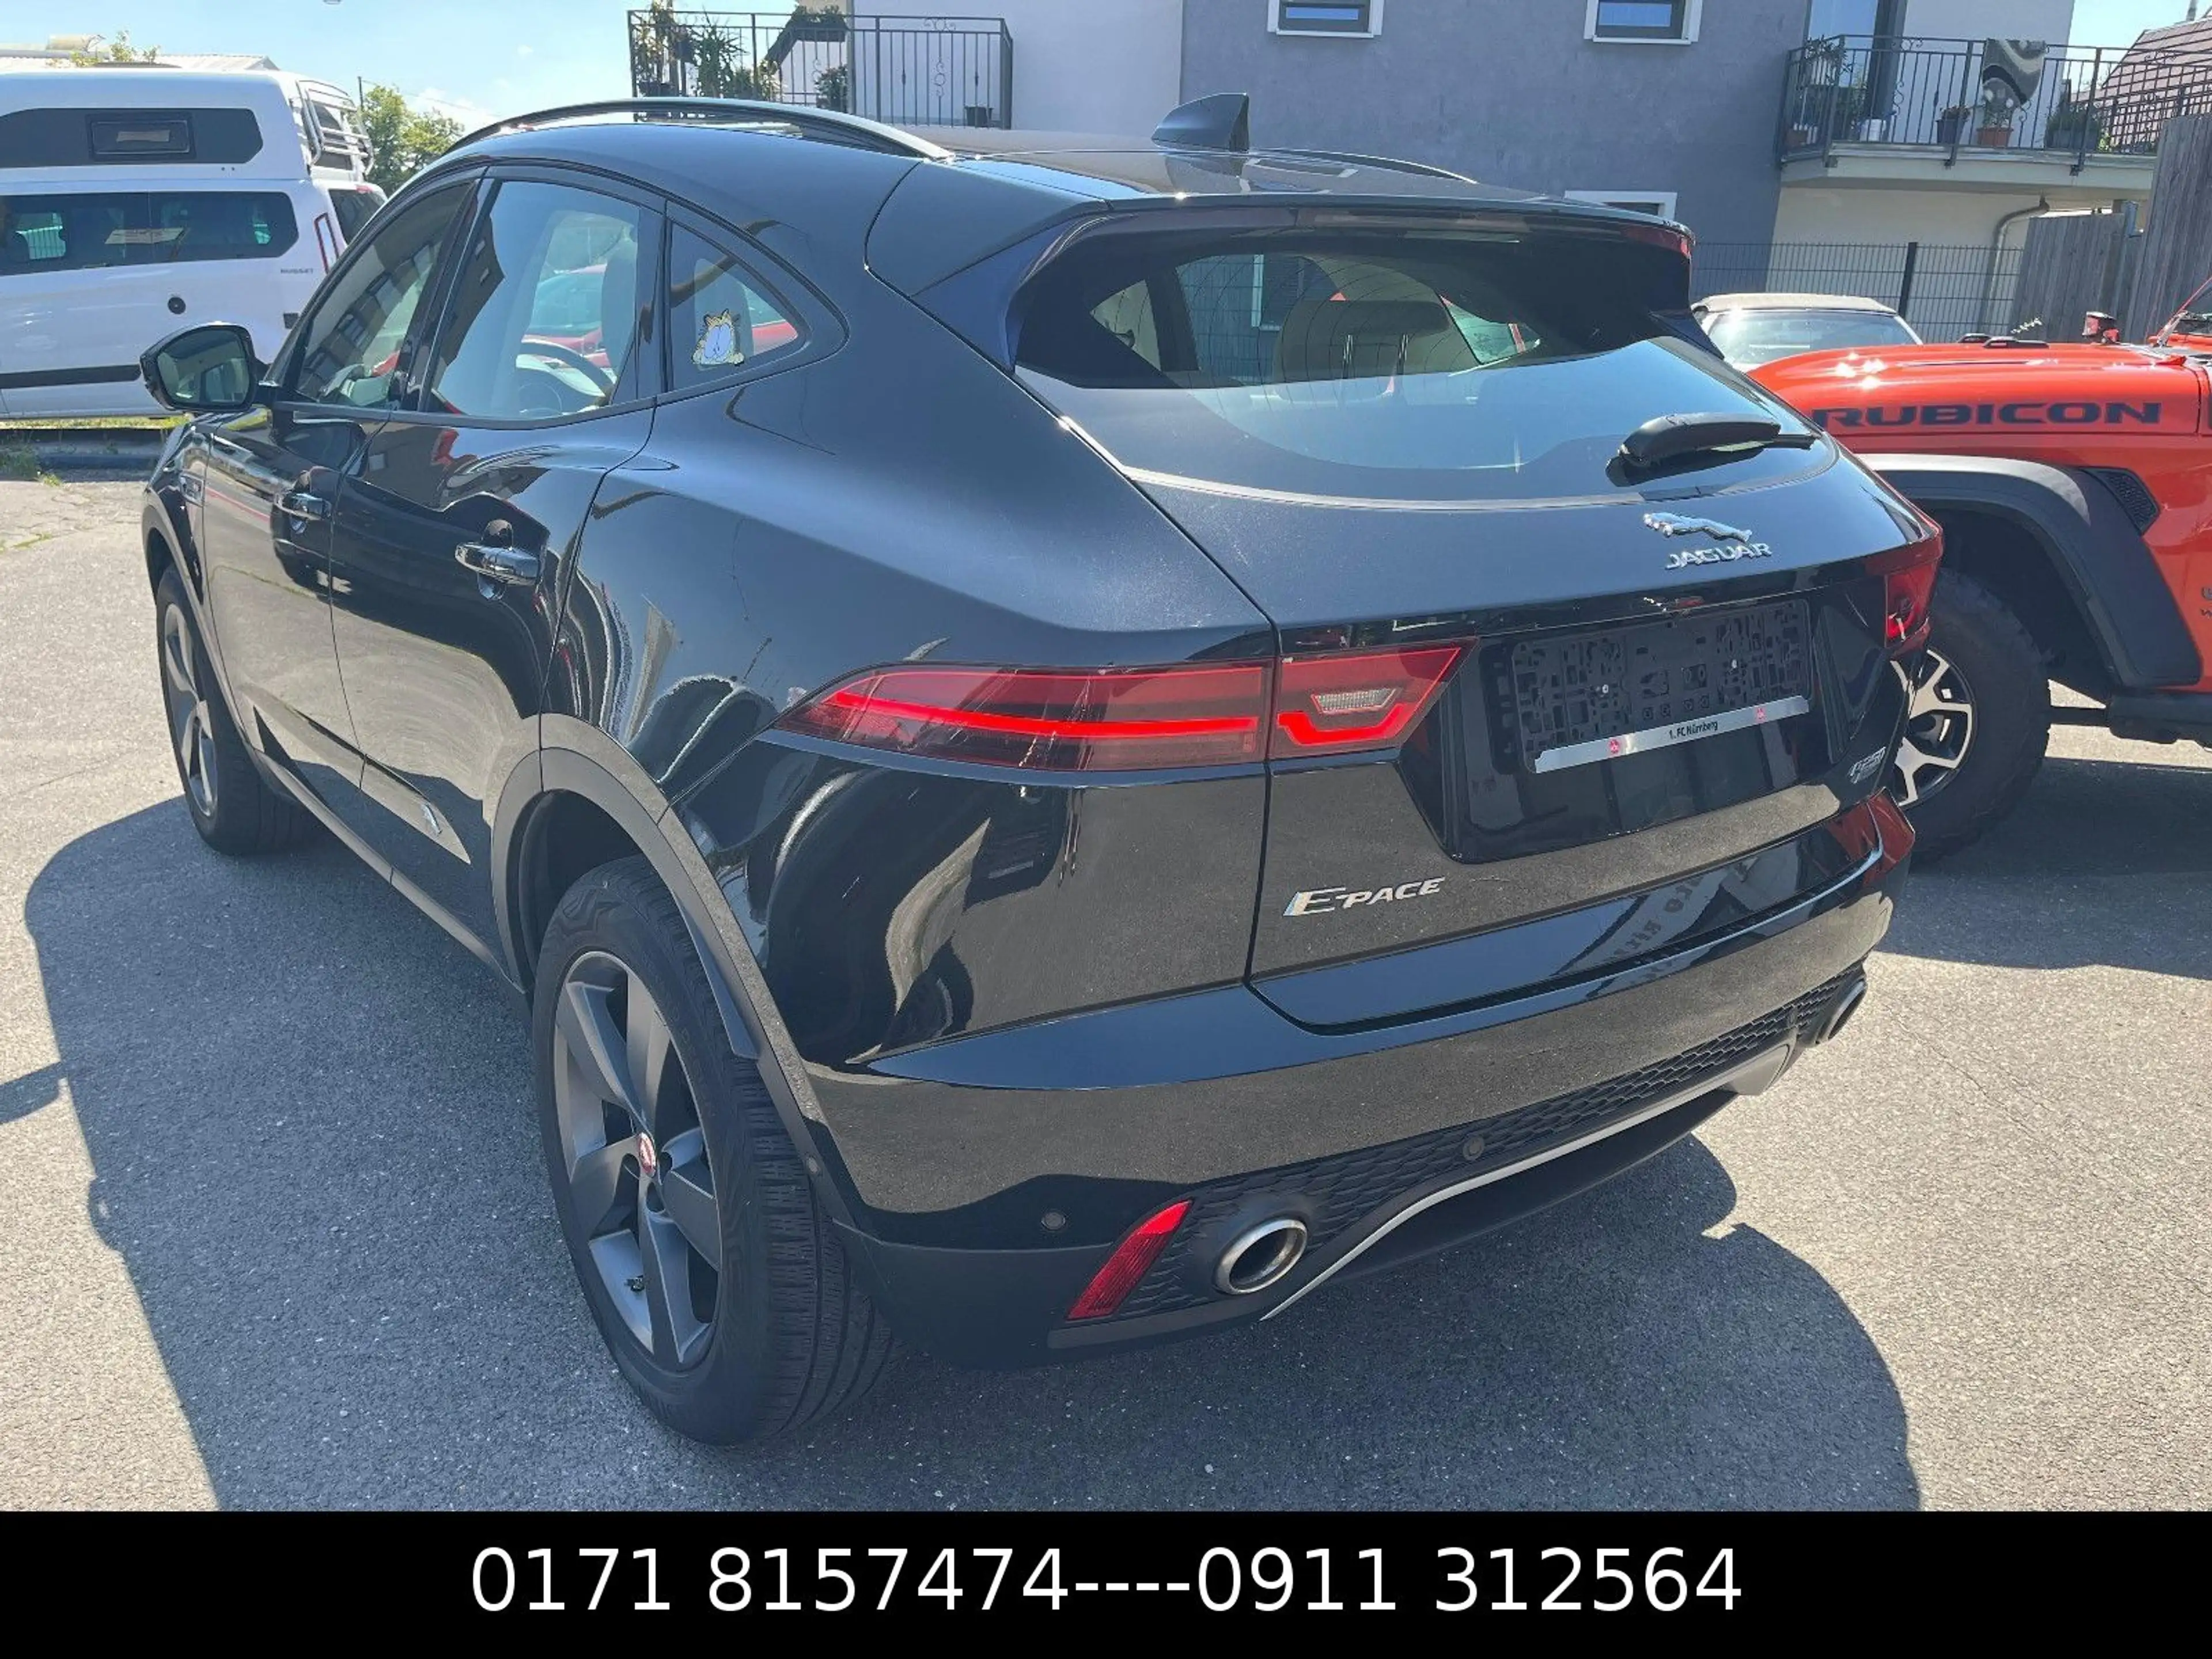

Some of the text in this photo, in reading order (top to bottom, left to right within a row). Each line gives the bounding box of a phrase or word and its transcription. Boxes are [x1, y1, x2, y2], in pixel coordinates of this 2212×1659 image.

[1812, 403, 2160, 429] RUBICON
[1665, 543, 1772, 569] JAGUAR
[1669, 730, 1676, 740] 1.
[1677, 726, 1686, 737] FC
